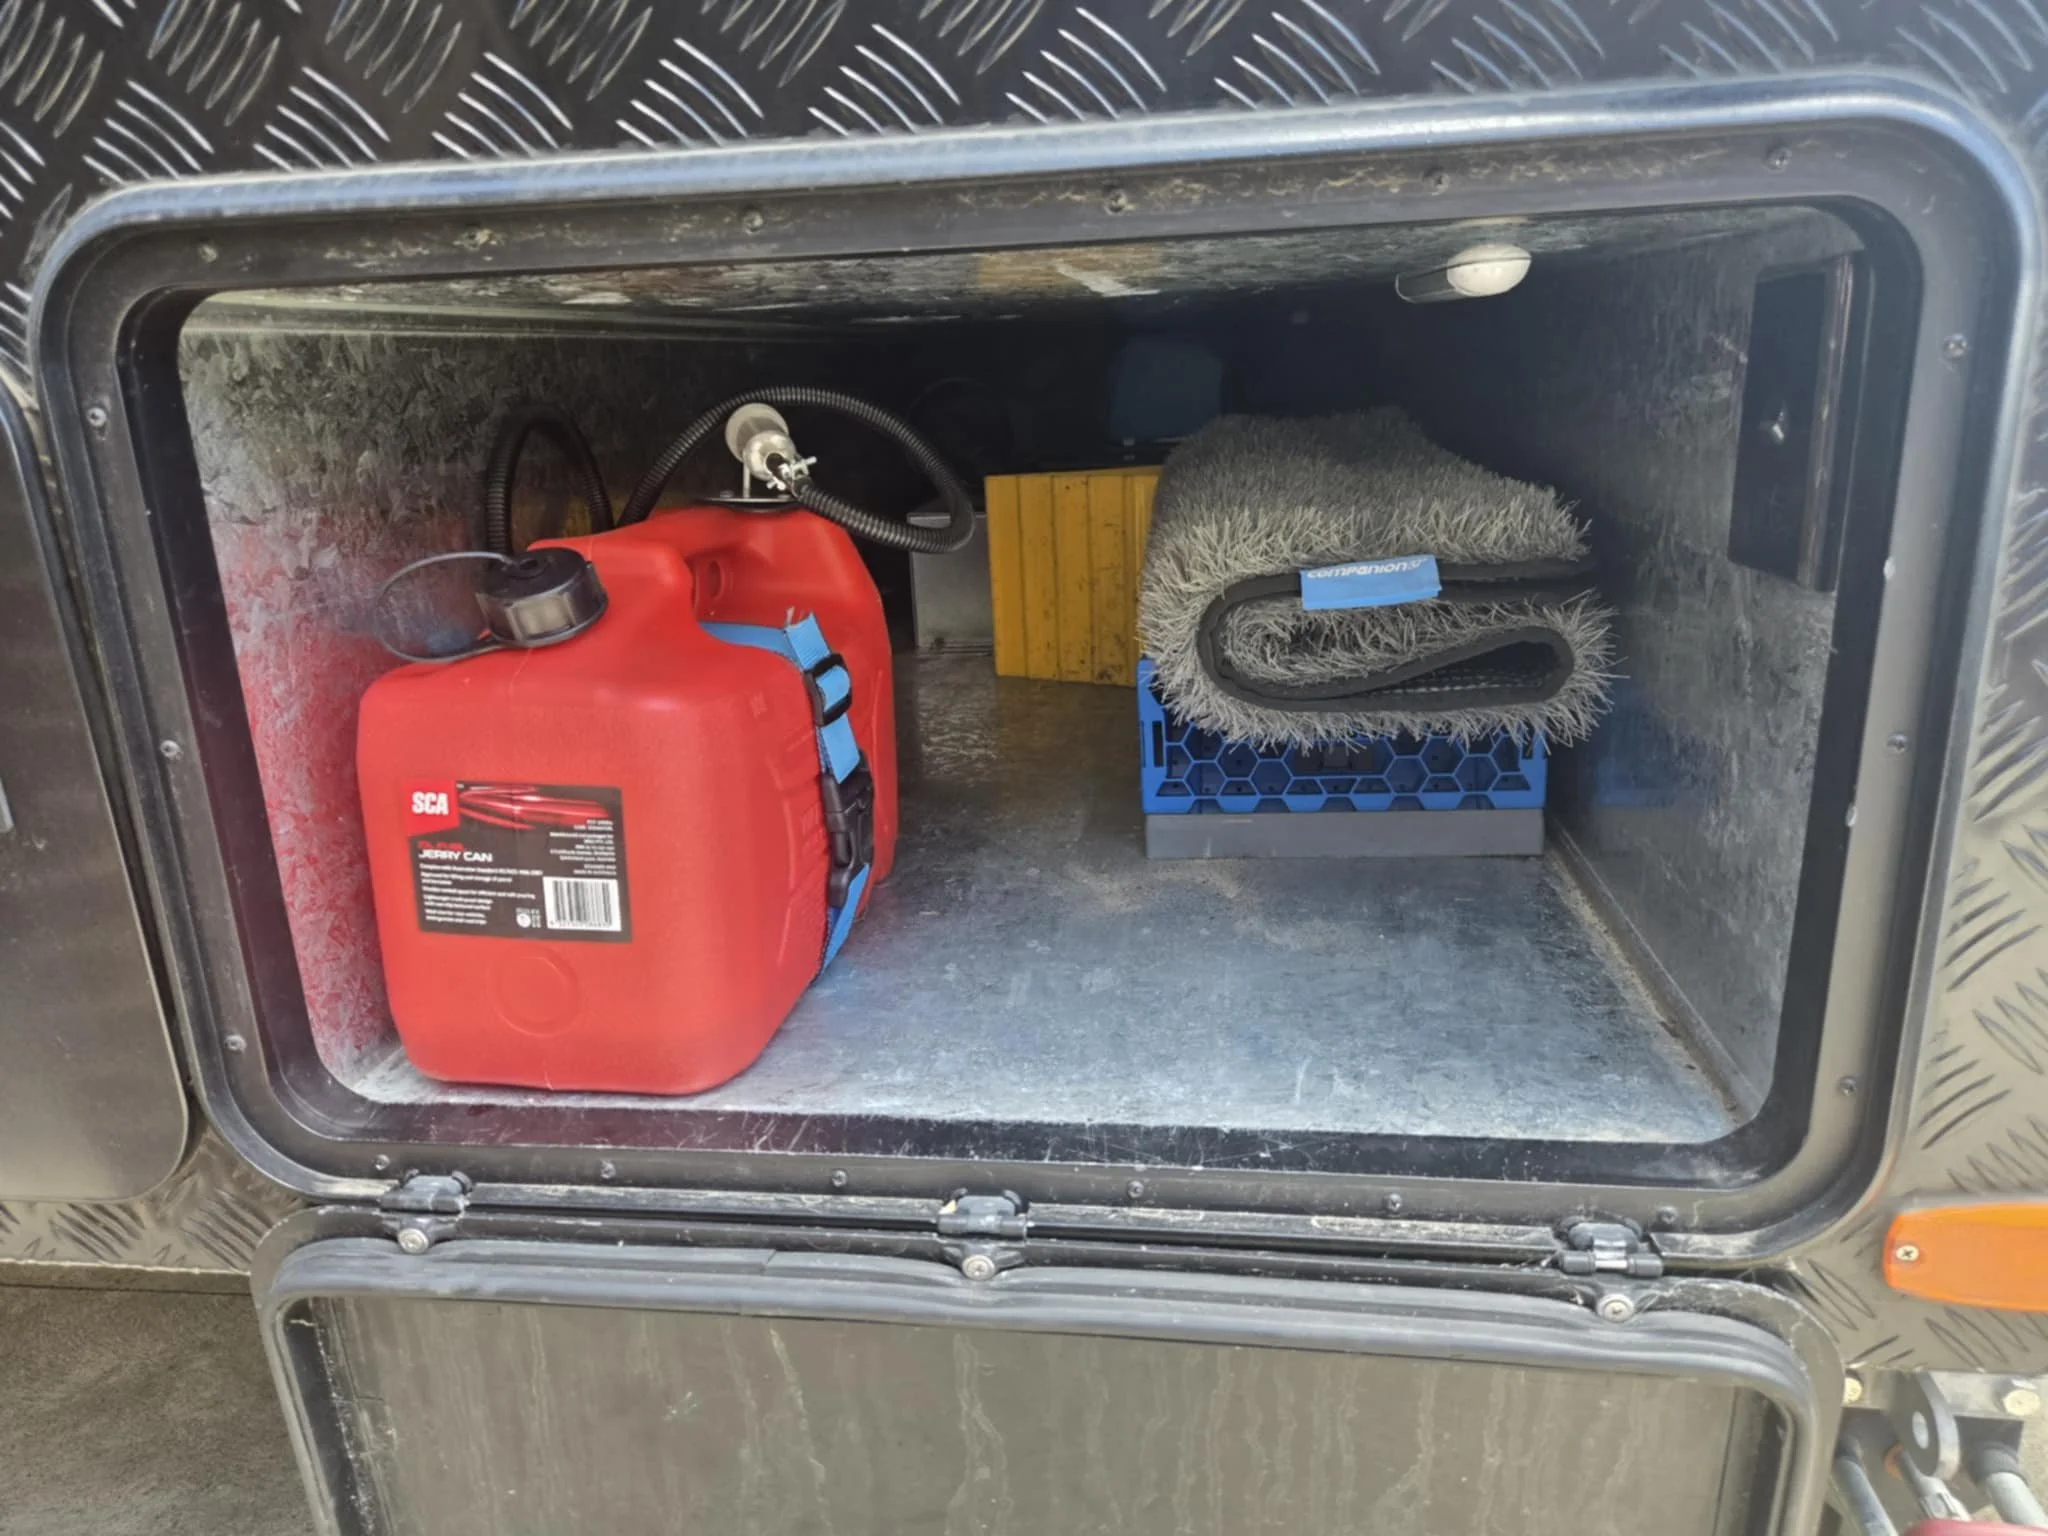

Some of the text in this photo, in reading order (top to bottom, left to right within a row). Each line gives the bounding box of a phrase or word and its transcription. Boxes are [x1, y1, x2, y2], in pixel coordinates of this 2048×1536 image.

[411, 791, 449, 816] SCA
[418, 849, 493, 863] JERRY CAN
